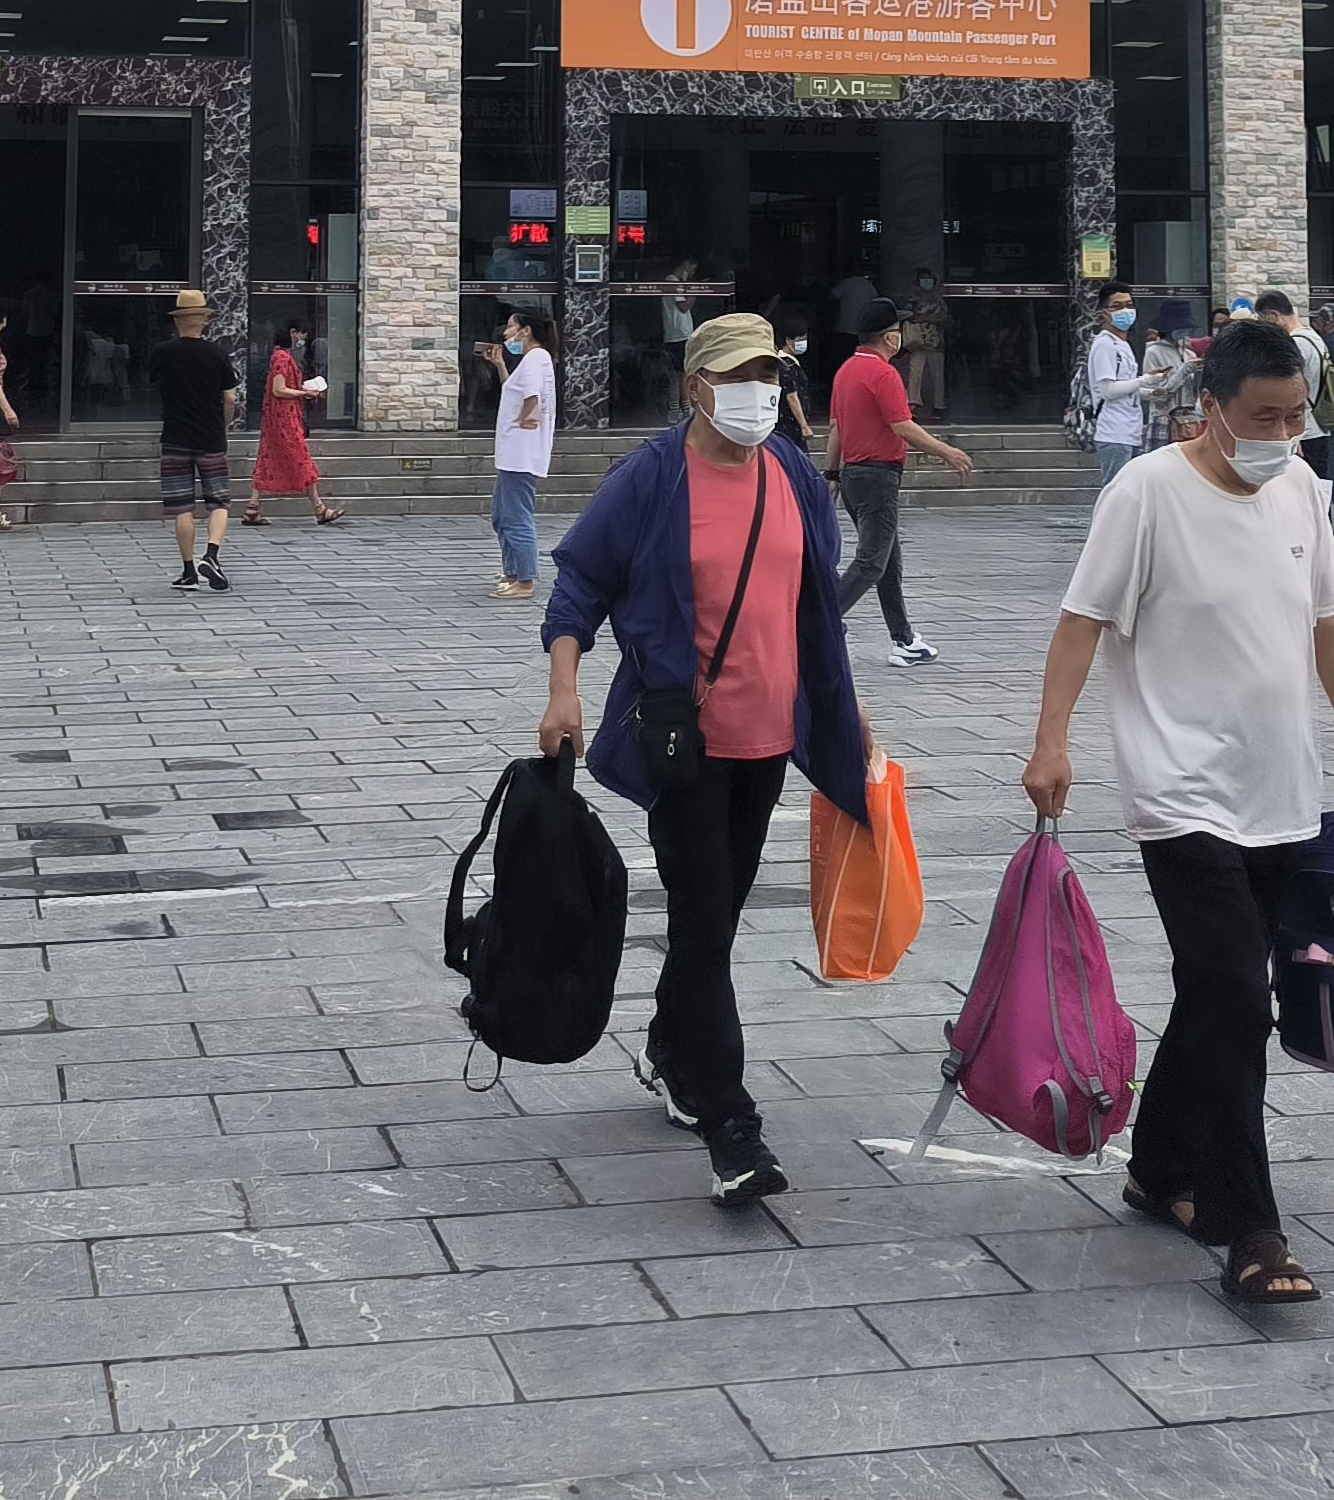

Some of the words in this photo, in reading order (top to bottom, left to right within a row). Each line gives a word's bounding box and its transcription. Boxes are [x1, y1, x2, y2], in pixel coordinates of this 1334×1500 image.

[745, 25, 795, 39] TOURIST
[801, 27, 844, 40] CENTRE
[848, 29, 859, 41] of
[863, 28, 903, 42] Mopan
[907, 29, 962, 43] Mountain
[966, 31, 1028, 45] Passenger
[1031, 33, 1057, 45] Port
[831, 79, 865, 95] 入口
